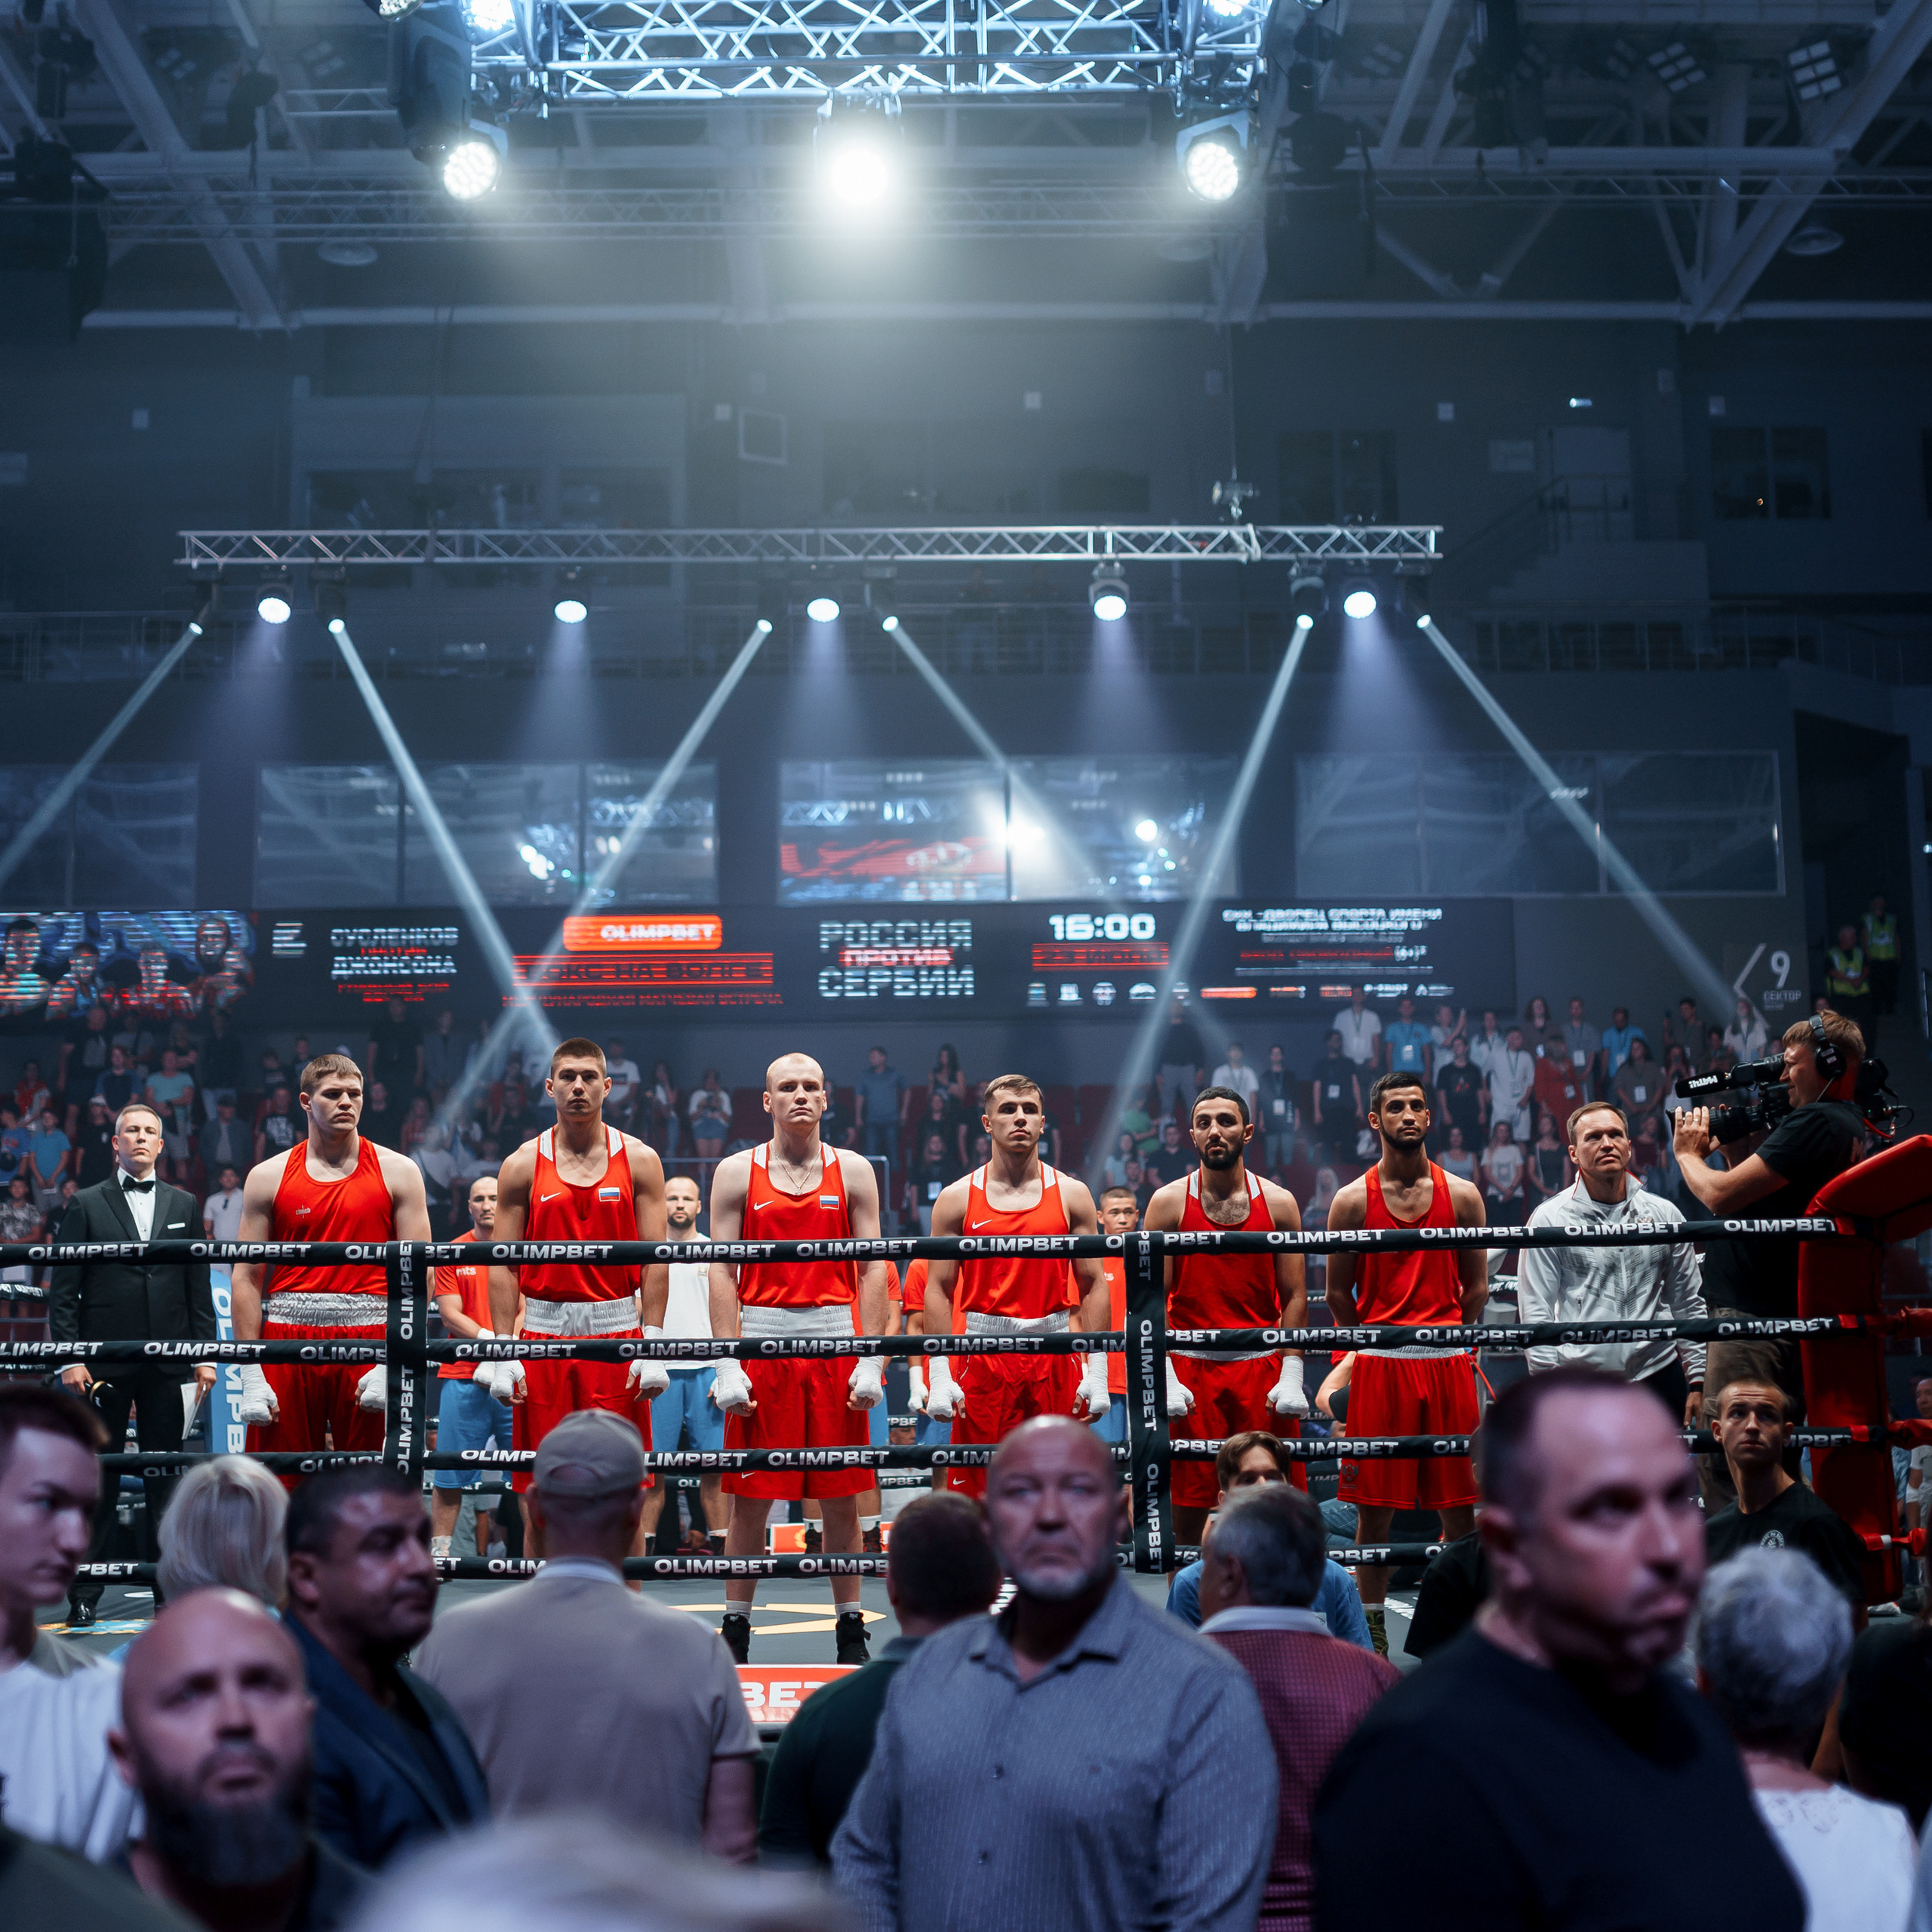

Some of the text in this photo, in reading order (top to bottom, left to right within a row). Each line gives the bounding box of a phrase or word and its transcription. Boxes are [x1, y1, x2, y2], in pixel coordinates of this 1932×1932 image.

[601, 924, 716, 940] OLIMPBET
[1049, 913, 1155, 940] 16:00
[819, 919, 972, 952] РОССИЯ
[1771, 951, 1791, 989] 9
[818, 965, 975, 998] СЕРБИИ
[1420, 1226, 1537, 1238] OLIMPBET
[1564, 1222, 1682, 1236] OLIMPBET
[1164, 1232, 1226, 1246] PBET
[1267, 1229, 1386, 1245] OLIMPBET
[29, 1244, 149, 1260] OLIMPBET
[190, 1243, 311, 1258] OLIMPBET
[492, 1244, 613, 1259] OLIMPBET
[655, 1244, 776, 1259] OLIMPBET
[796, 1239, 917, 1257] OLIMPBET
[959, 1238, 1079, 1253] OLIMPBET
[1137, 1231, 1151, 1281] PBET
[1718, 1318, 1832, 1336] OLIMPBET
[1262, 1329, 1381, 1343] OLIMPBET
[1415, 1329, 1534, 1343] OLIMPBET
[1560, 1327, 1676, 1343] OLIMPBET
[0, 1343, 103, 1356] LIMPBET
[144, 1342, 266, 1358] OLIMPBET
[455, 1343, 576, 1358] OLIMPBET
[619, 1342, 740, 1357] OLIMPBET
[760, 1340, 881, 1355] OLIMPBET
[923, 1337, 1044, 1352] OLIMPBET
[1072, 1339, 1125, 1352] OLIM
[1140, 1320, 1157, 1432] OLIMPBET
[397, 1365, 414, 1475] OLIMPBET
[1171, 1439, 1227, 1454] PBE
[461, 1450, 537, 1462] OLIMP
[644, 1452, 748, 1467] LIMPBET
[768, 1451, 890, 1466] OLIMPBET
[931, 1450, 995, 1465] OLIM
[878, 1476, 924, 1486] MPBET
[1146, 1463, 1164, 1573] OLIMPBET
[1328, 1549, 1391, 1564] PBET
[77, 1563, 138, 1576] PBET
[488, 1559, 547, 1574] OLIM
[654, 1559, 777, 1574] OLIMPBET
[799, 1558, 889, 1573] OLIMPB
